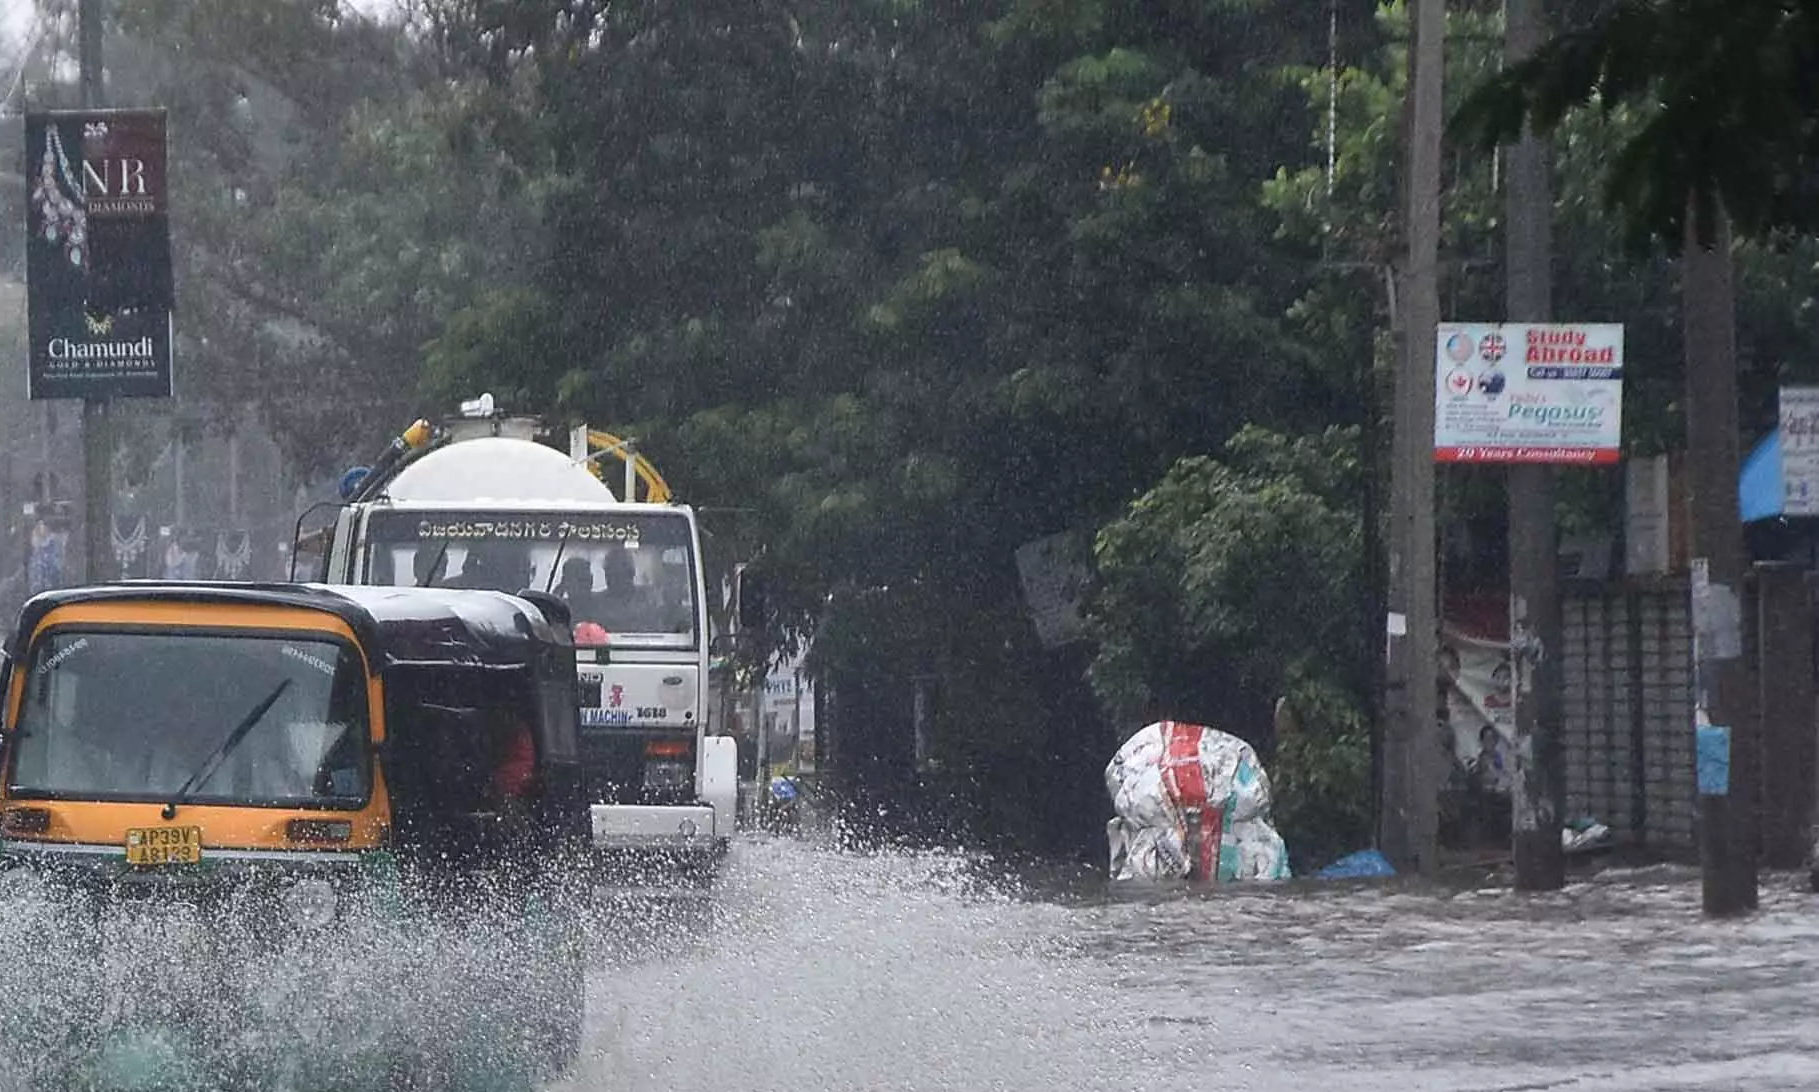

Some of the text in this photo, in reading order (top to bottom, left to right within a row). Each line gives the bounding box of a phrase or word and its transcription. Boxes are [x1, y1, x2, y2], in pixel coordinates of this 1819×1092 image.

[88, 202, 155, 213] DIAMONDS
[1525, 328, 1587, 345] Study
[48, 336, 153, 358] Chamundi
[1525, 346, 1614, 364] Abroad
[96, 359, 156, 368] DIAMONDS
